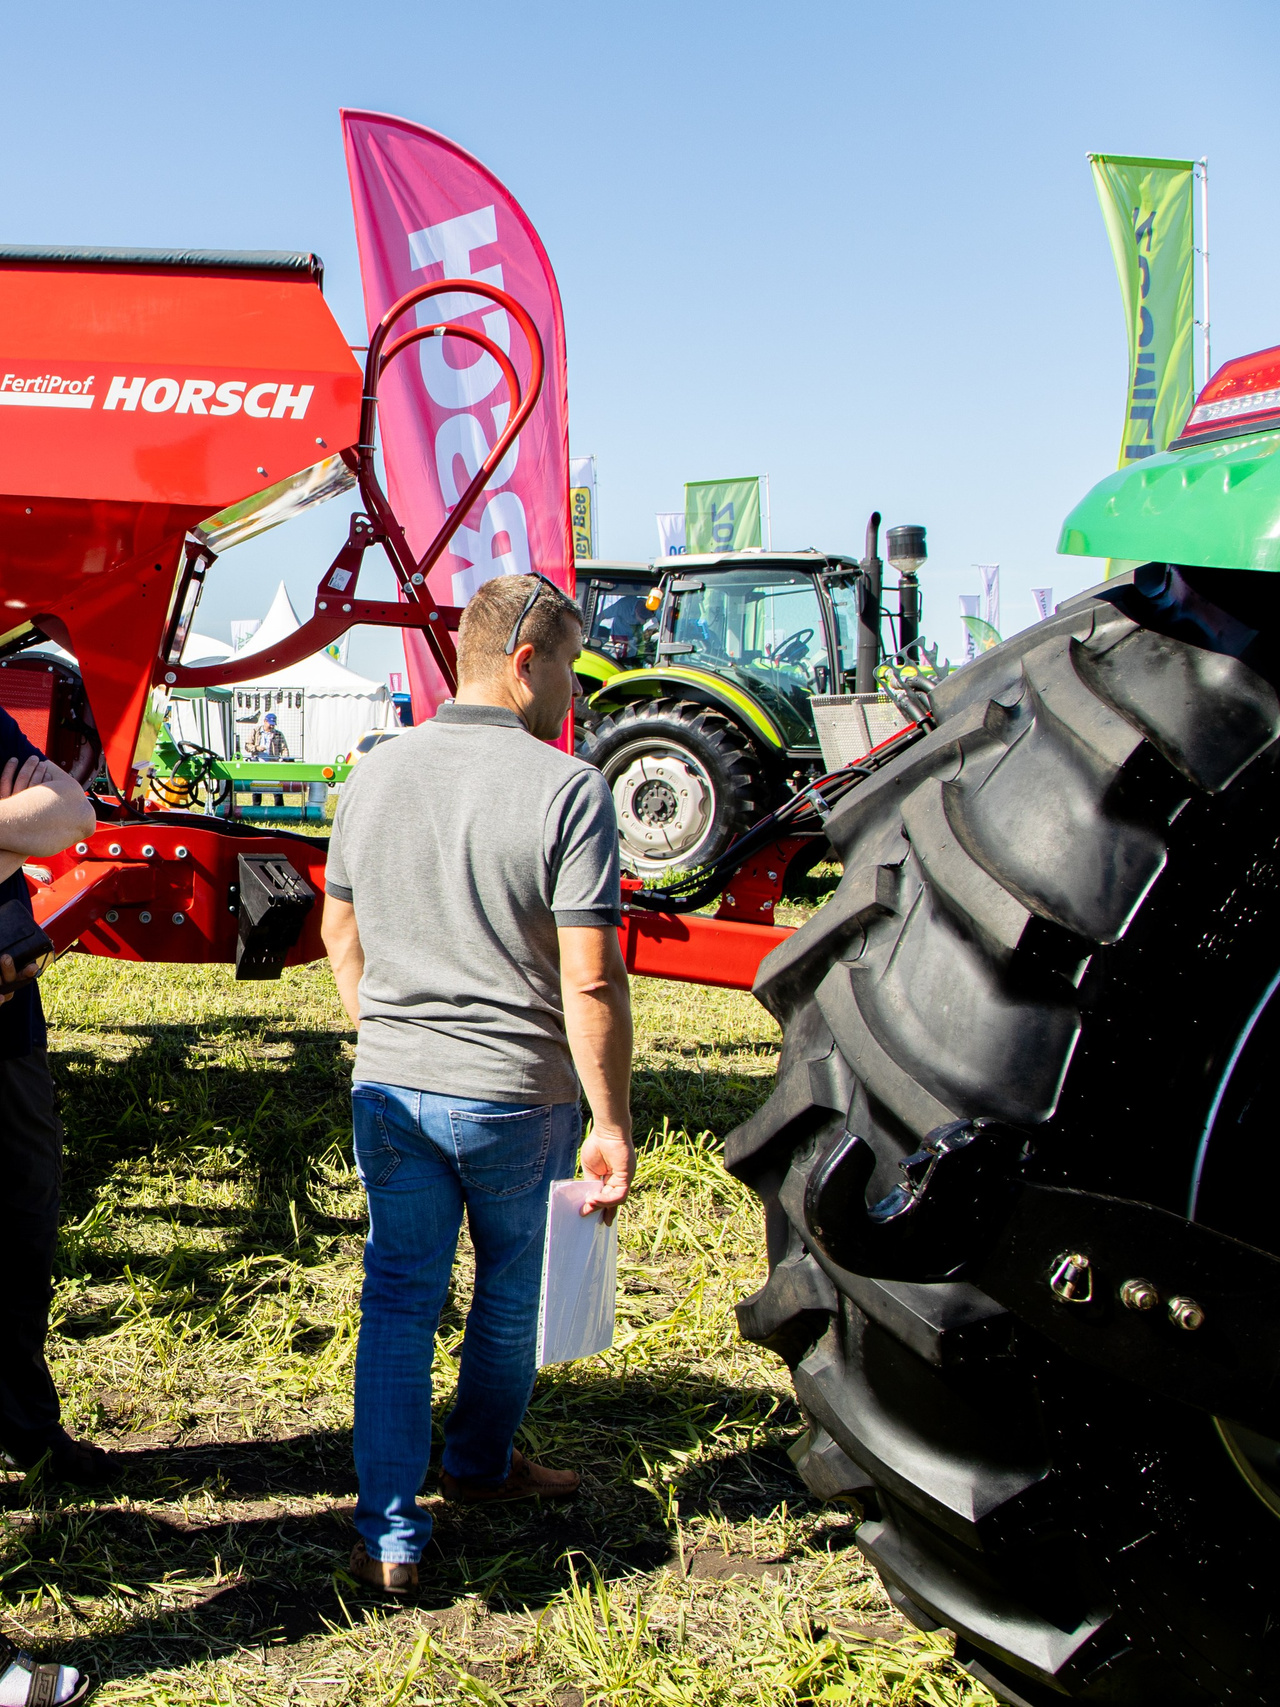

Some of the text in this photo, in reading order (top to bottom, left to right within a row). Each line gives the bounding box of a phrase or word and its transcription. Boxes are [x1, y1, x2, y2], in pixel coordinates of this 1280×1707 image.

[0, 373, 315, 420] FertiProf HORSCH
[572, 493, 587, 529] Bee
